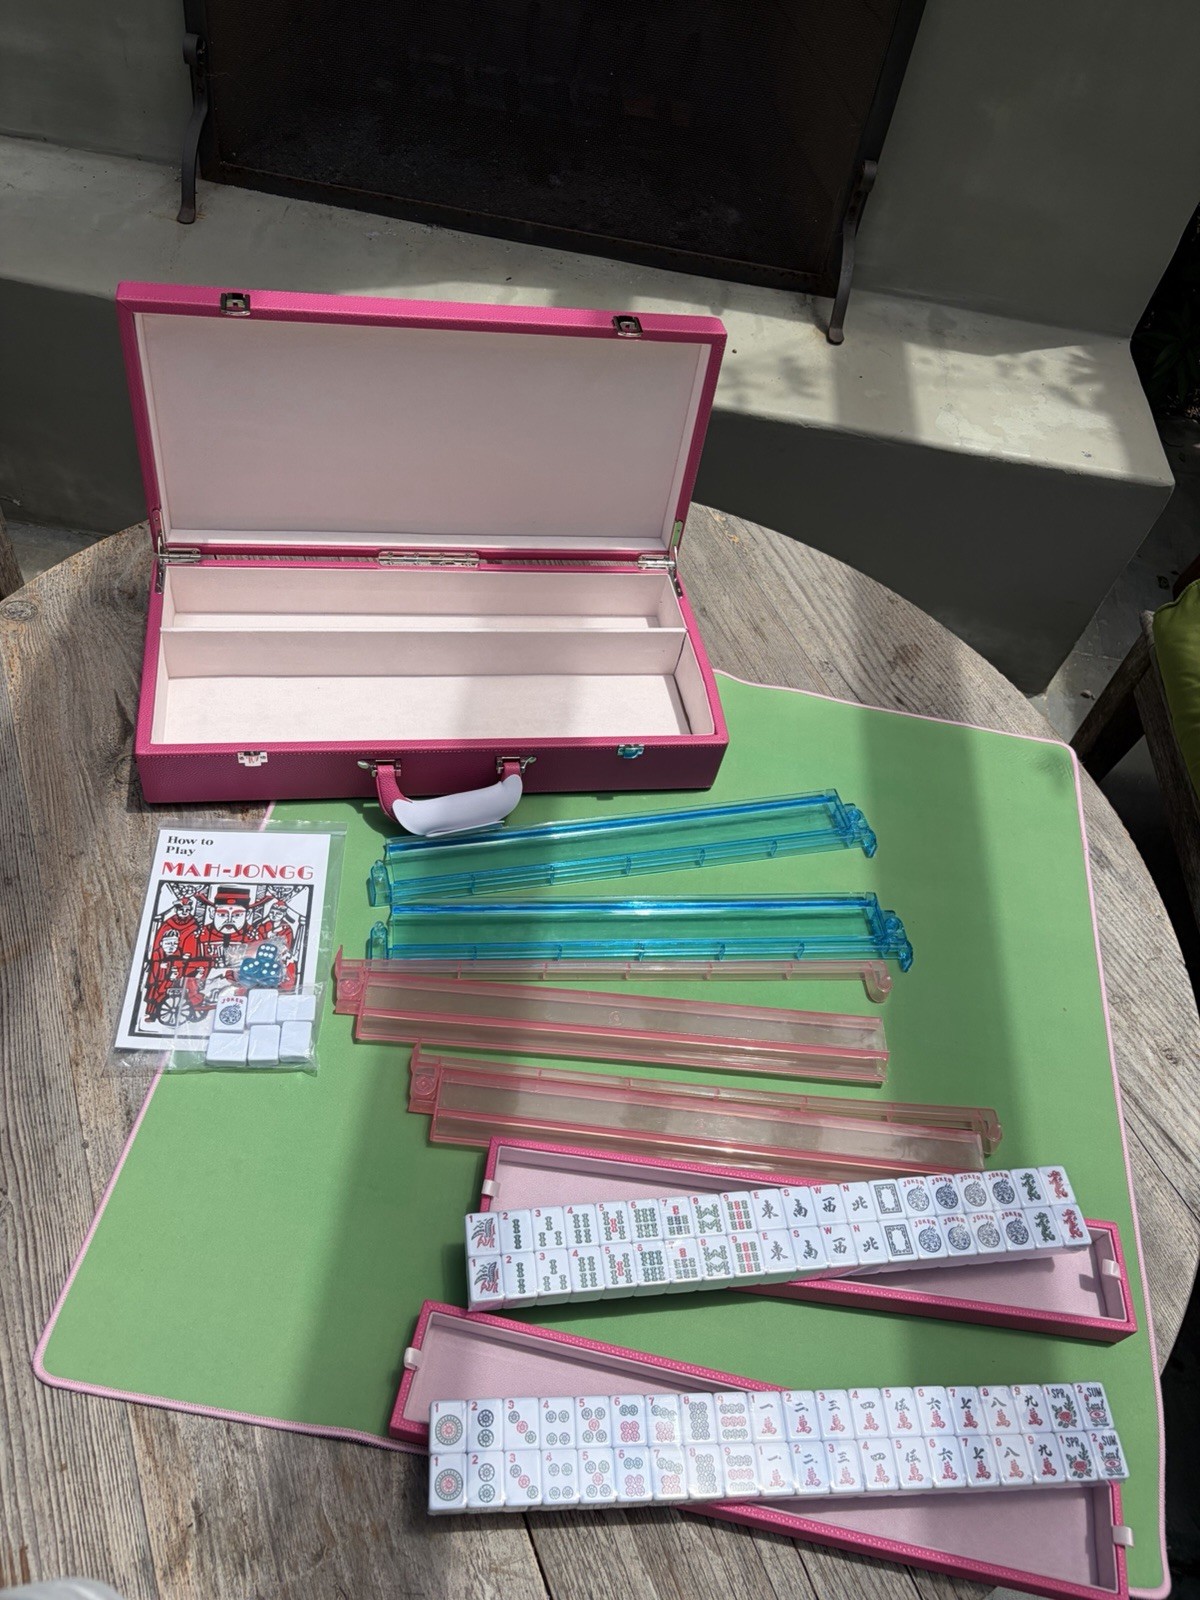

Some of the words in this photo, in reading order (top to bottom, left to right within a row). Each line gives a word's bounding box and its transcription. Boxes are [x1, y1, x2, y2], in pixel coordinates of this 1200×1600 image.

[167, 835, 198, 845] How
[201, 836, 214, 846] to
[166, 846, 196, 856] Play
[162, 862, 314, 880] MAH-JONGG
[931, 1175, 953, 1184] JOKER
[959, 1174, 981, 1183] JOKER
[988, 1171, 1009, 1180] JOKER
[903, 1179, 924, 1188] JOKER
[784, 1189, 790, 1197] S
[693, 1196, 699, 1204] 8
[723, 1194, 730, 1202] 9
[599, 1204, 605, 1212] 5
[630, 1201, 637, 1209] 6
[793, 1198, 808, 1218] 南
[822, 1198, 836, 1213] 西
[852, 1196, 868, 1211] 北
[535, 1209, 541, 1218] 3
[762, 1200, 778, 1219] 東
[502, 1211, 508, 1220] 2
[972, 1214, 994, 1223] JOKER
[1000, 1211, 1022, 1220] JOKER
[914, 1219, 936, 1228] JOKER
[943, 1216, 964, 1225] JOKER
[700, 1239, 706, 1247] 8
[832, 1238, 847, 1253] 西
[863, 1237, 879, 1252] 北
[770, 1241, 788, 1260] 東
[802, 1240, 818, 1260] 南
[506, 1255, 512, 1263] 2
[539, 1252, 545, 1260] 3
[852, 1391, 858, 1399] 4
[885, 1390, 891, 1398] 5
[918, 1389, 924, 1398] 6
[950, 1388, 956, 1397] 7
[982, 1388, 989, 1396] 8
[1014, 1386, 1021, 1395] 9
[1046, 1387, 1050, 1395] 1
[1051, 1389, 1066, 1399] SPR
[1077, 1385, 1083, 1394] 2
[1086, 1387, 1102, 1397] SUM
[648, 1397, 655, 1405] 7
[683, 1396, 690, 1405] 8
[717, 1395, 724, 1404] 9
[751, 1394, 755, 1403] 1
[785, 1393, 792, 1402] 2
[819, 1392, 826, 1401] 3
[471, 1402, 478, 1410] 2
[508, 1400, 514, 1409] 3
[543, 1400, 550, 1408] 4
[579, 1398, 585, 1407] 5
[614, 1398, 621, 1406] 6
[434, 1403, 439, 1412] 1
[929, 1439, 936, 1448] 6
[962, 1438, 968, 1447] 7
[995, 1437, 1002, 1446] 8
[1028, 1436, 1034, 1444] 9
[1060, 1435, 1064, 1444] 1
[1066, 1438, 1080, 1448] SPR
[1091, 1433, 1098, 1442] 2
[1102, 1436, 1118, 1446] SUM
[794, 1444, 801, 1453] 2
[828, 1443, 834, 1452] 3
[862, 1442, 869, 1450] 4
[895, 1440, 902, 1449] 5
[618, 1450, 625, 1458] 6
[654, 1449, 660, 1458] 7
[689, 1448, 696, 1457] 8
[724, 1447, 731, 1456] 9
[759, 1446, 763, 1455] 1
[472, 1455, 478, 1464] 2
[509, 1454, 516, 1463] 3
[545, 1452, 552, 1461] 4
[582, 1451, 589, 1460] 5
[434, 1457, 439, 1466] 1
